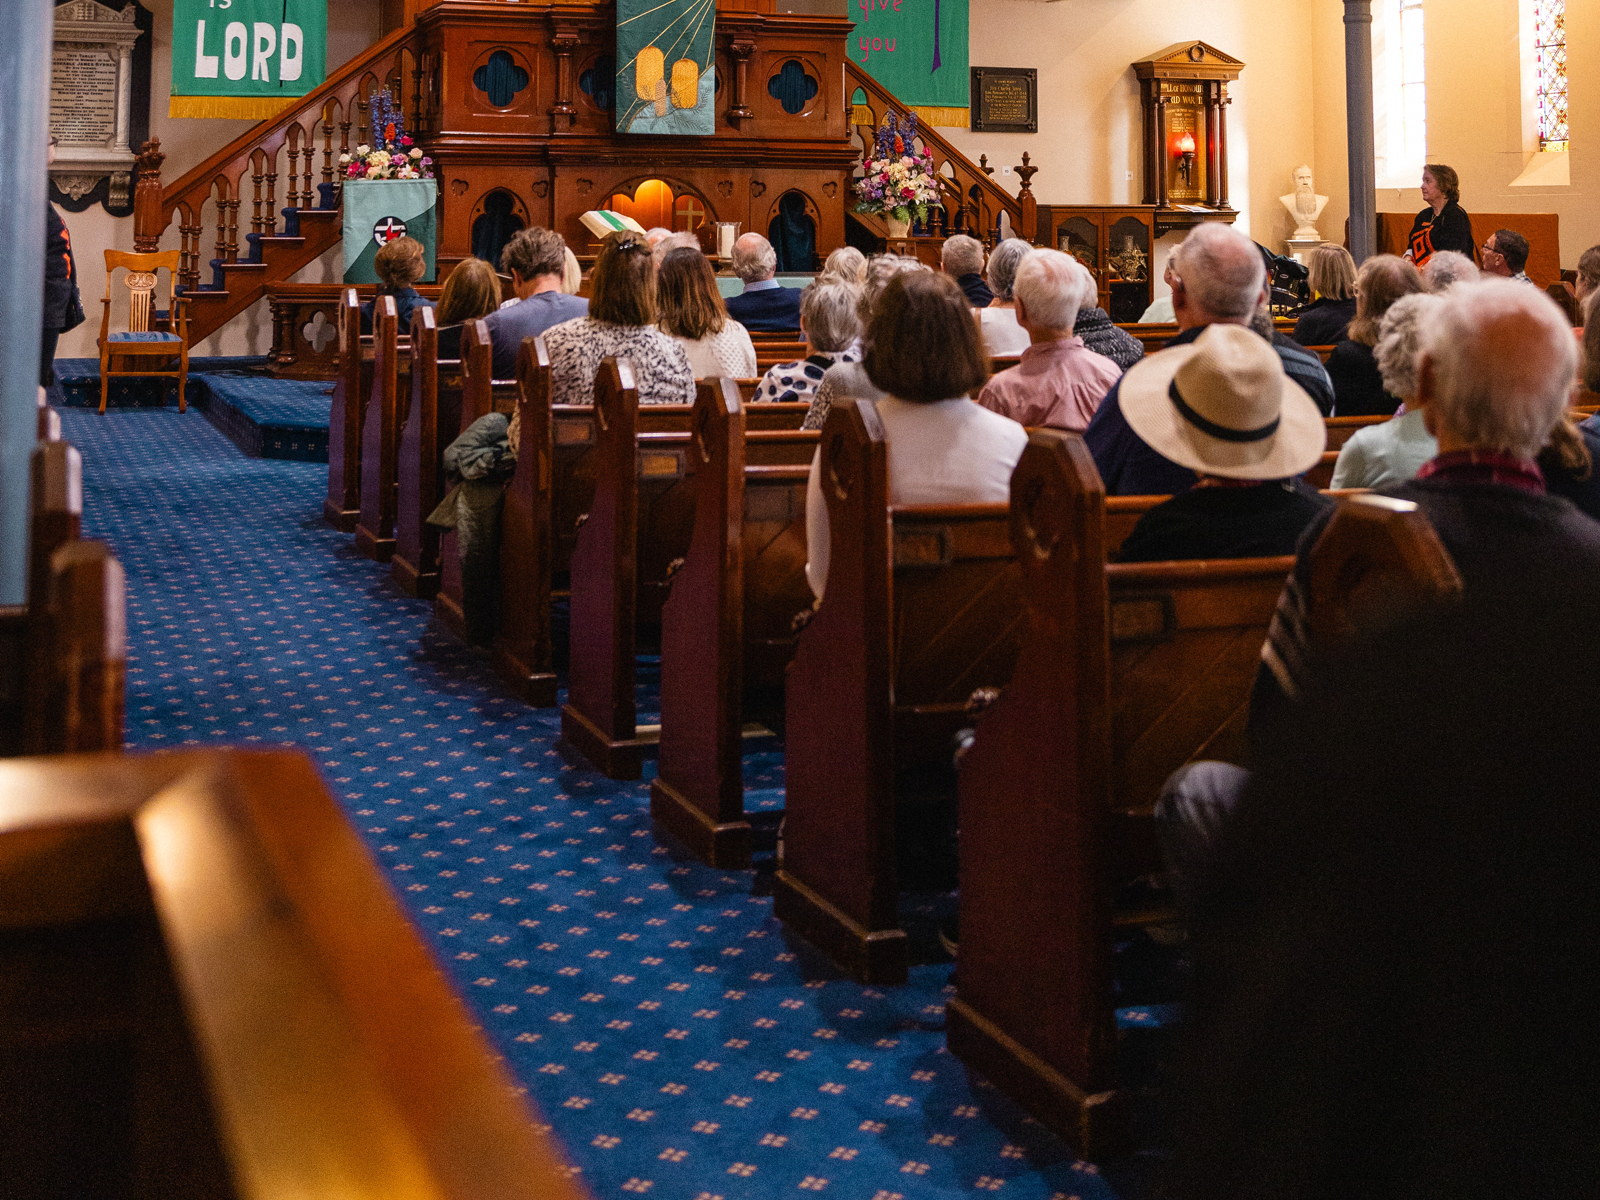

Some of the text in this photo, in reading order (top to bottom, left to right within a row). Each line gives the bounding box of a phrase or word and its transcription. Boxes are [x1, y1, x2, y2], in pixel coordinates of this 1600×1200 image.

[195, 20, 303, 82] LORD
[858, 36, 897, 62] you
[1183, 96, 1195, 104] WAR
